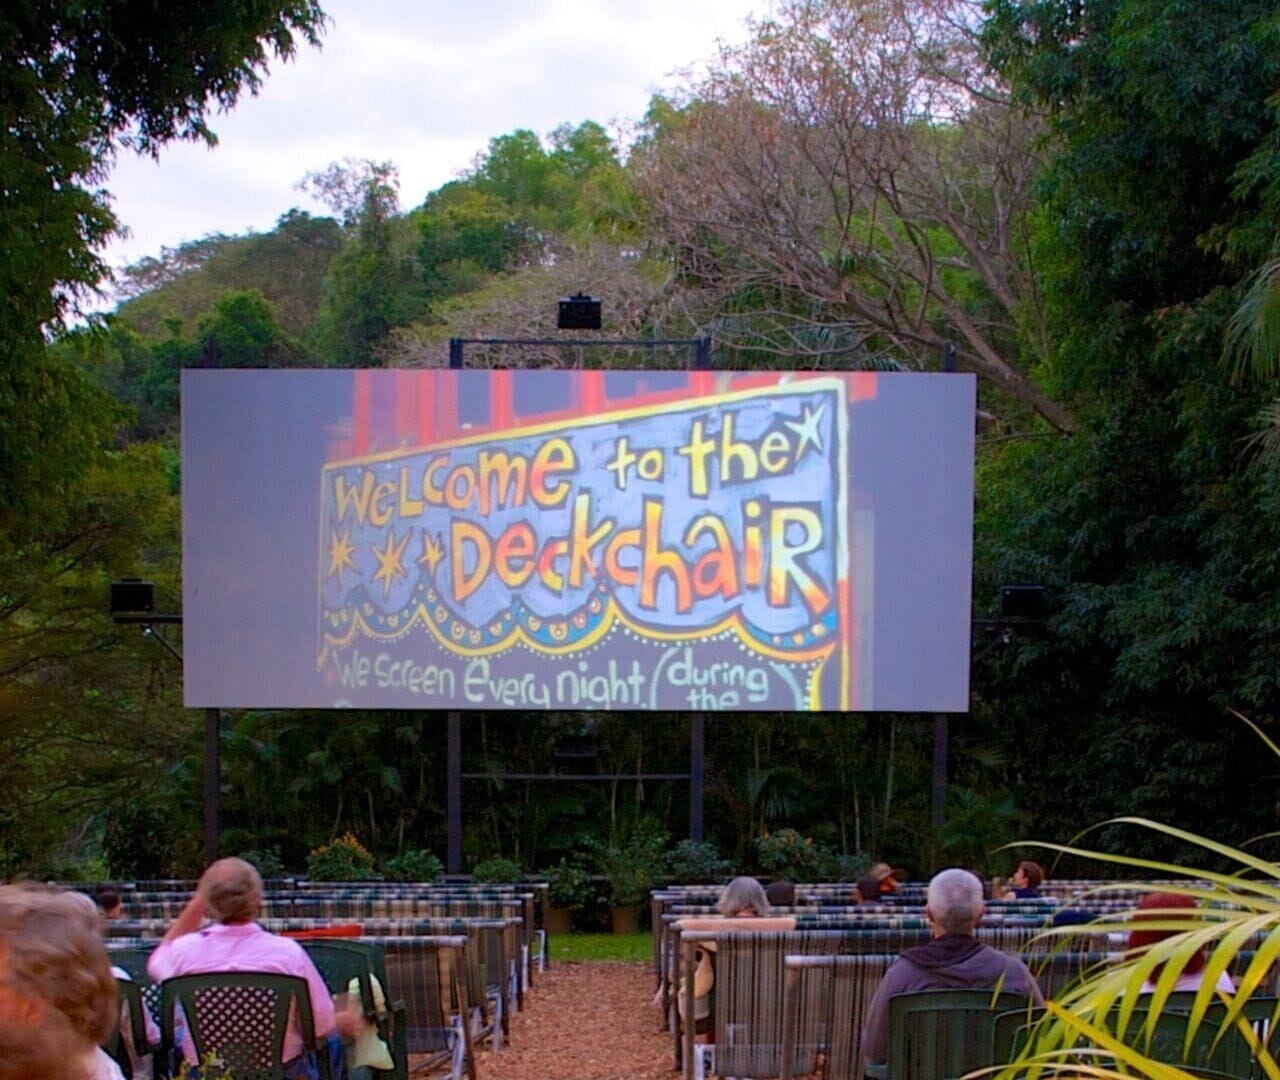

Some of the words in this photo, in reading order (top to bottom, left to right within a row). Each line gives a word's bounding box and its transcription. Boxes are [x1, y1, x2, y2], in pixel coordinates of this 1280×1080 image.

[607, 437, 664, 488] to
[678, 414, 791, 494] the
[332, 649, 371, 688] We
[686, 686, 740, 710] the
